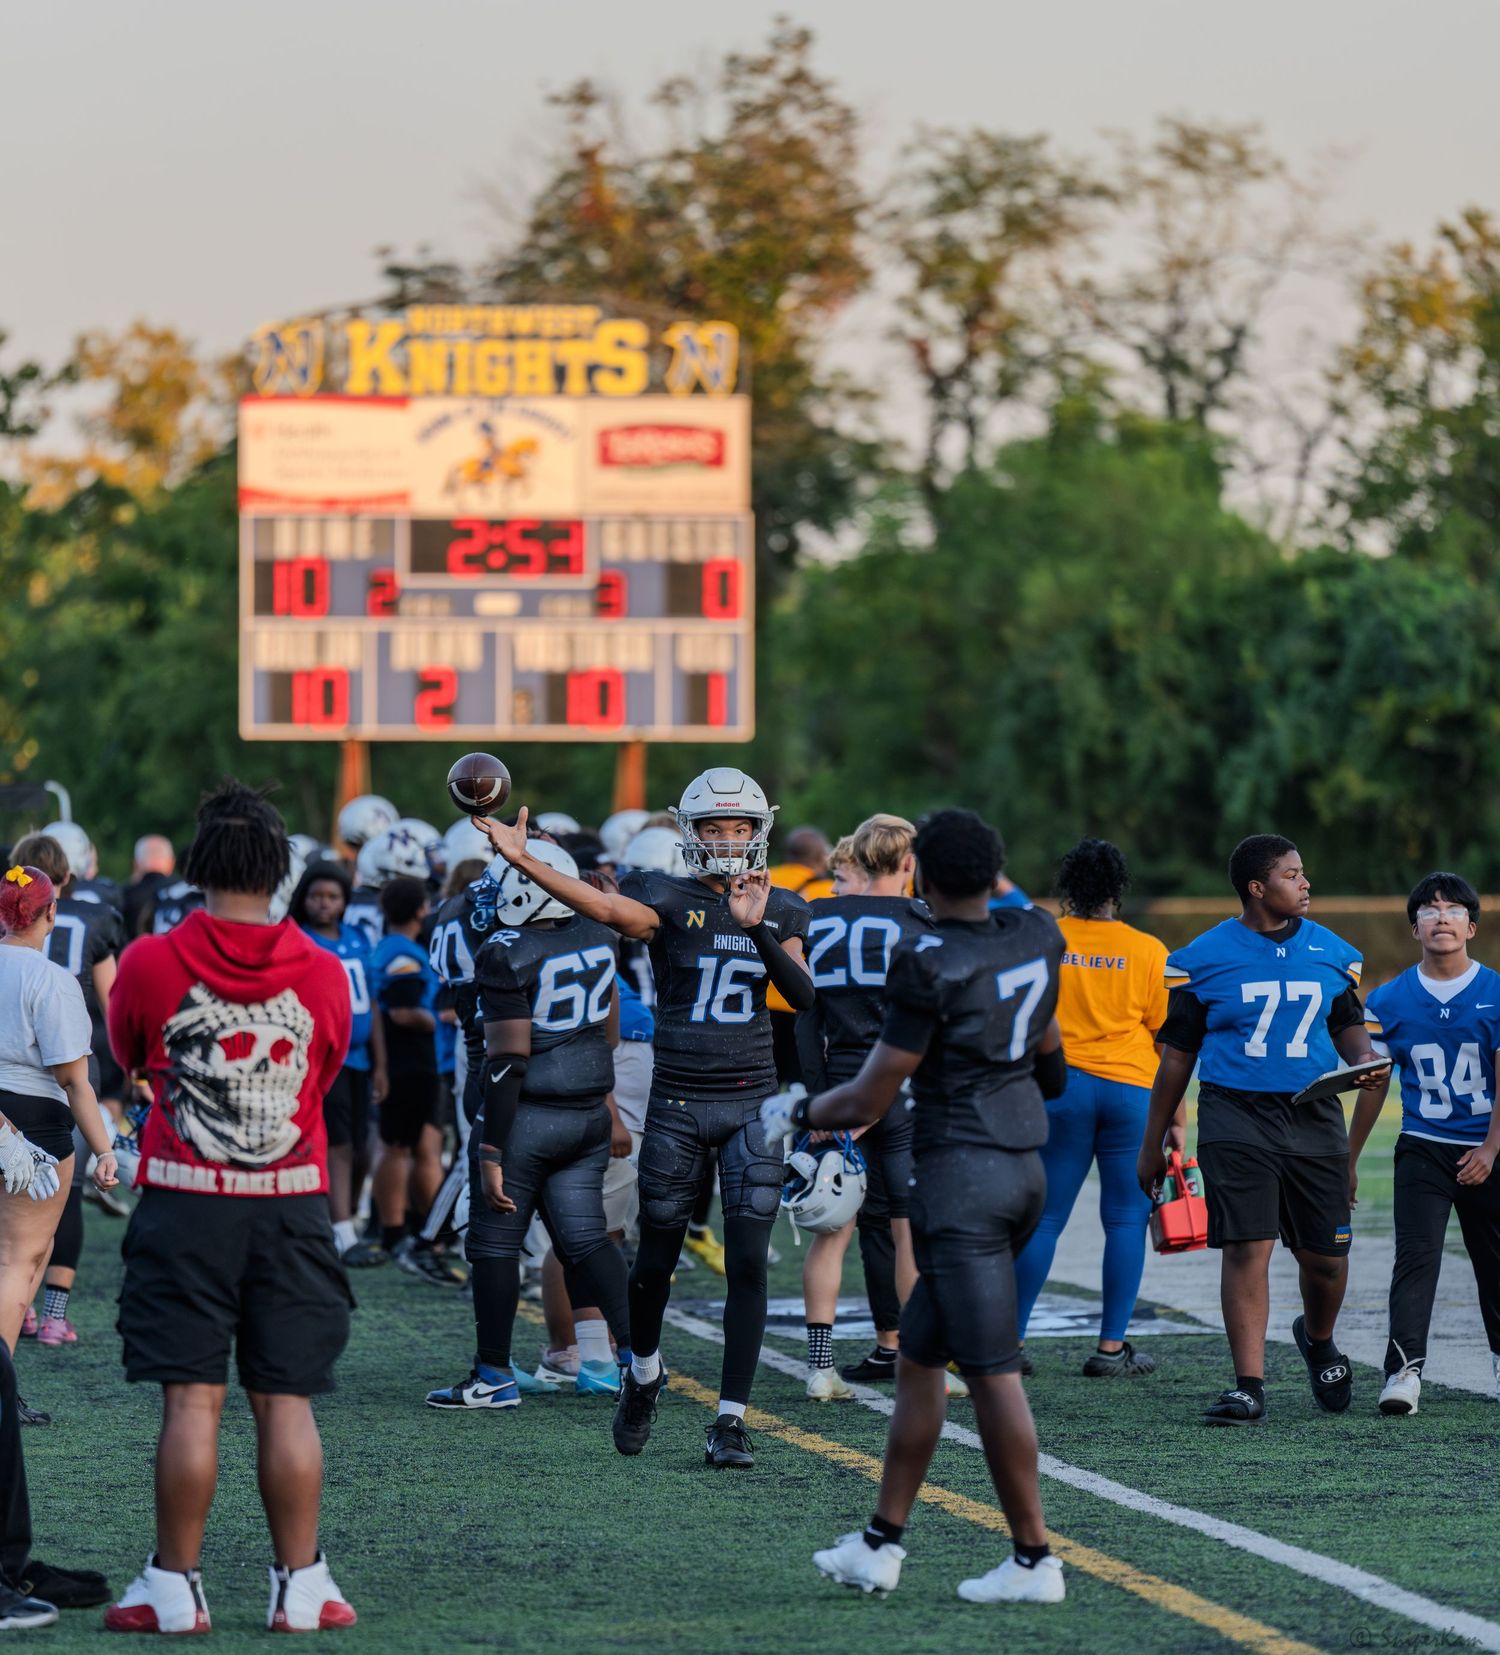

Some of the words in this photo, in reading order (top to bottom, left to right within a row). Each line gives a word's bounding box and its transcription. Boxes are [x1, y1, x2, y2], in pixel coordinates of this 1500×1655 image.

[346, 319, 648, 396] KNIGHTS
[273, 555, 329, 618] 10
[702, 556, 745, 621] 0
[292, 665, 350, 732] 10
[414, 665, 458, 732] 2
[566, 666, 625, 732] 10
[707, 669, 727, 728] 1
[488, 929, 520, 947] 62
[686, 910, 706, 929] N
[713, 934, 758, 954] KNIGHTS
[808, 915, 901, 988] 20
[1276, 947, 1286, 958] N
[532, 943, 617, 1031] 62
[690, 956, 768, 1023] 16
[1060, 953, 1126, 970] BELIEVE
[997, 956, 1050, 1062] 7
[1241, 980, 1323, 1058] 77
[1440, 1008, 1450, 1020] N
[1410, 1042, 1493, 1119] 84
